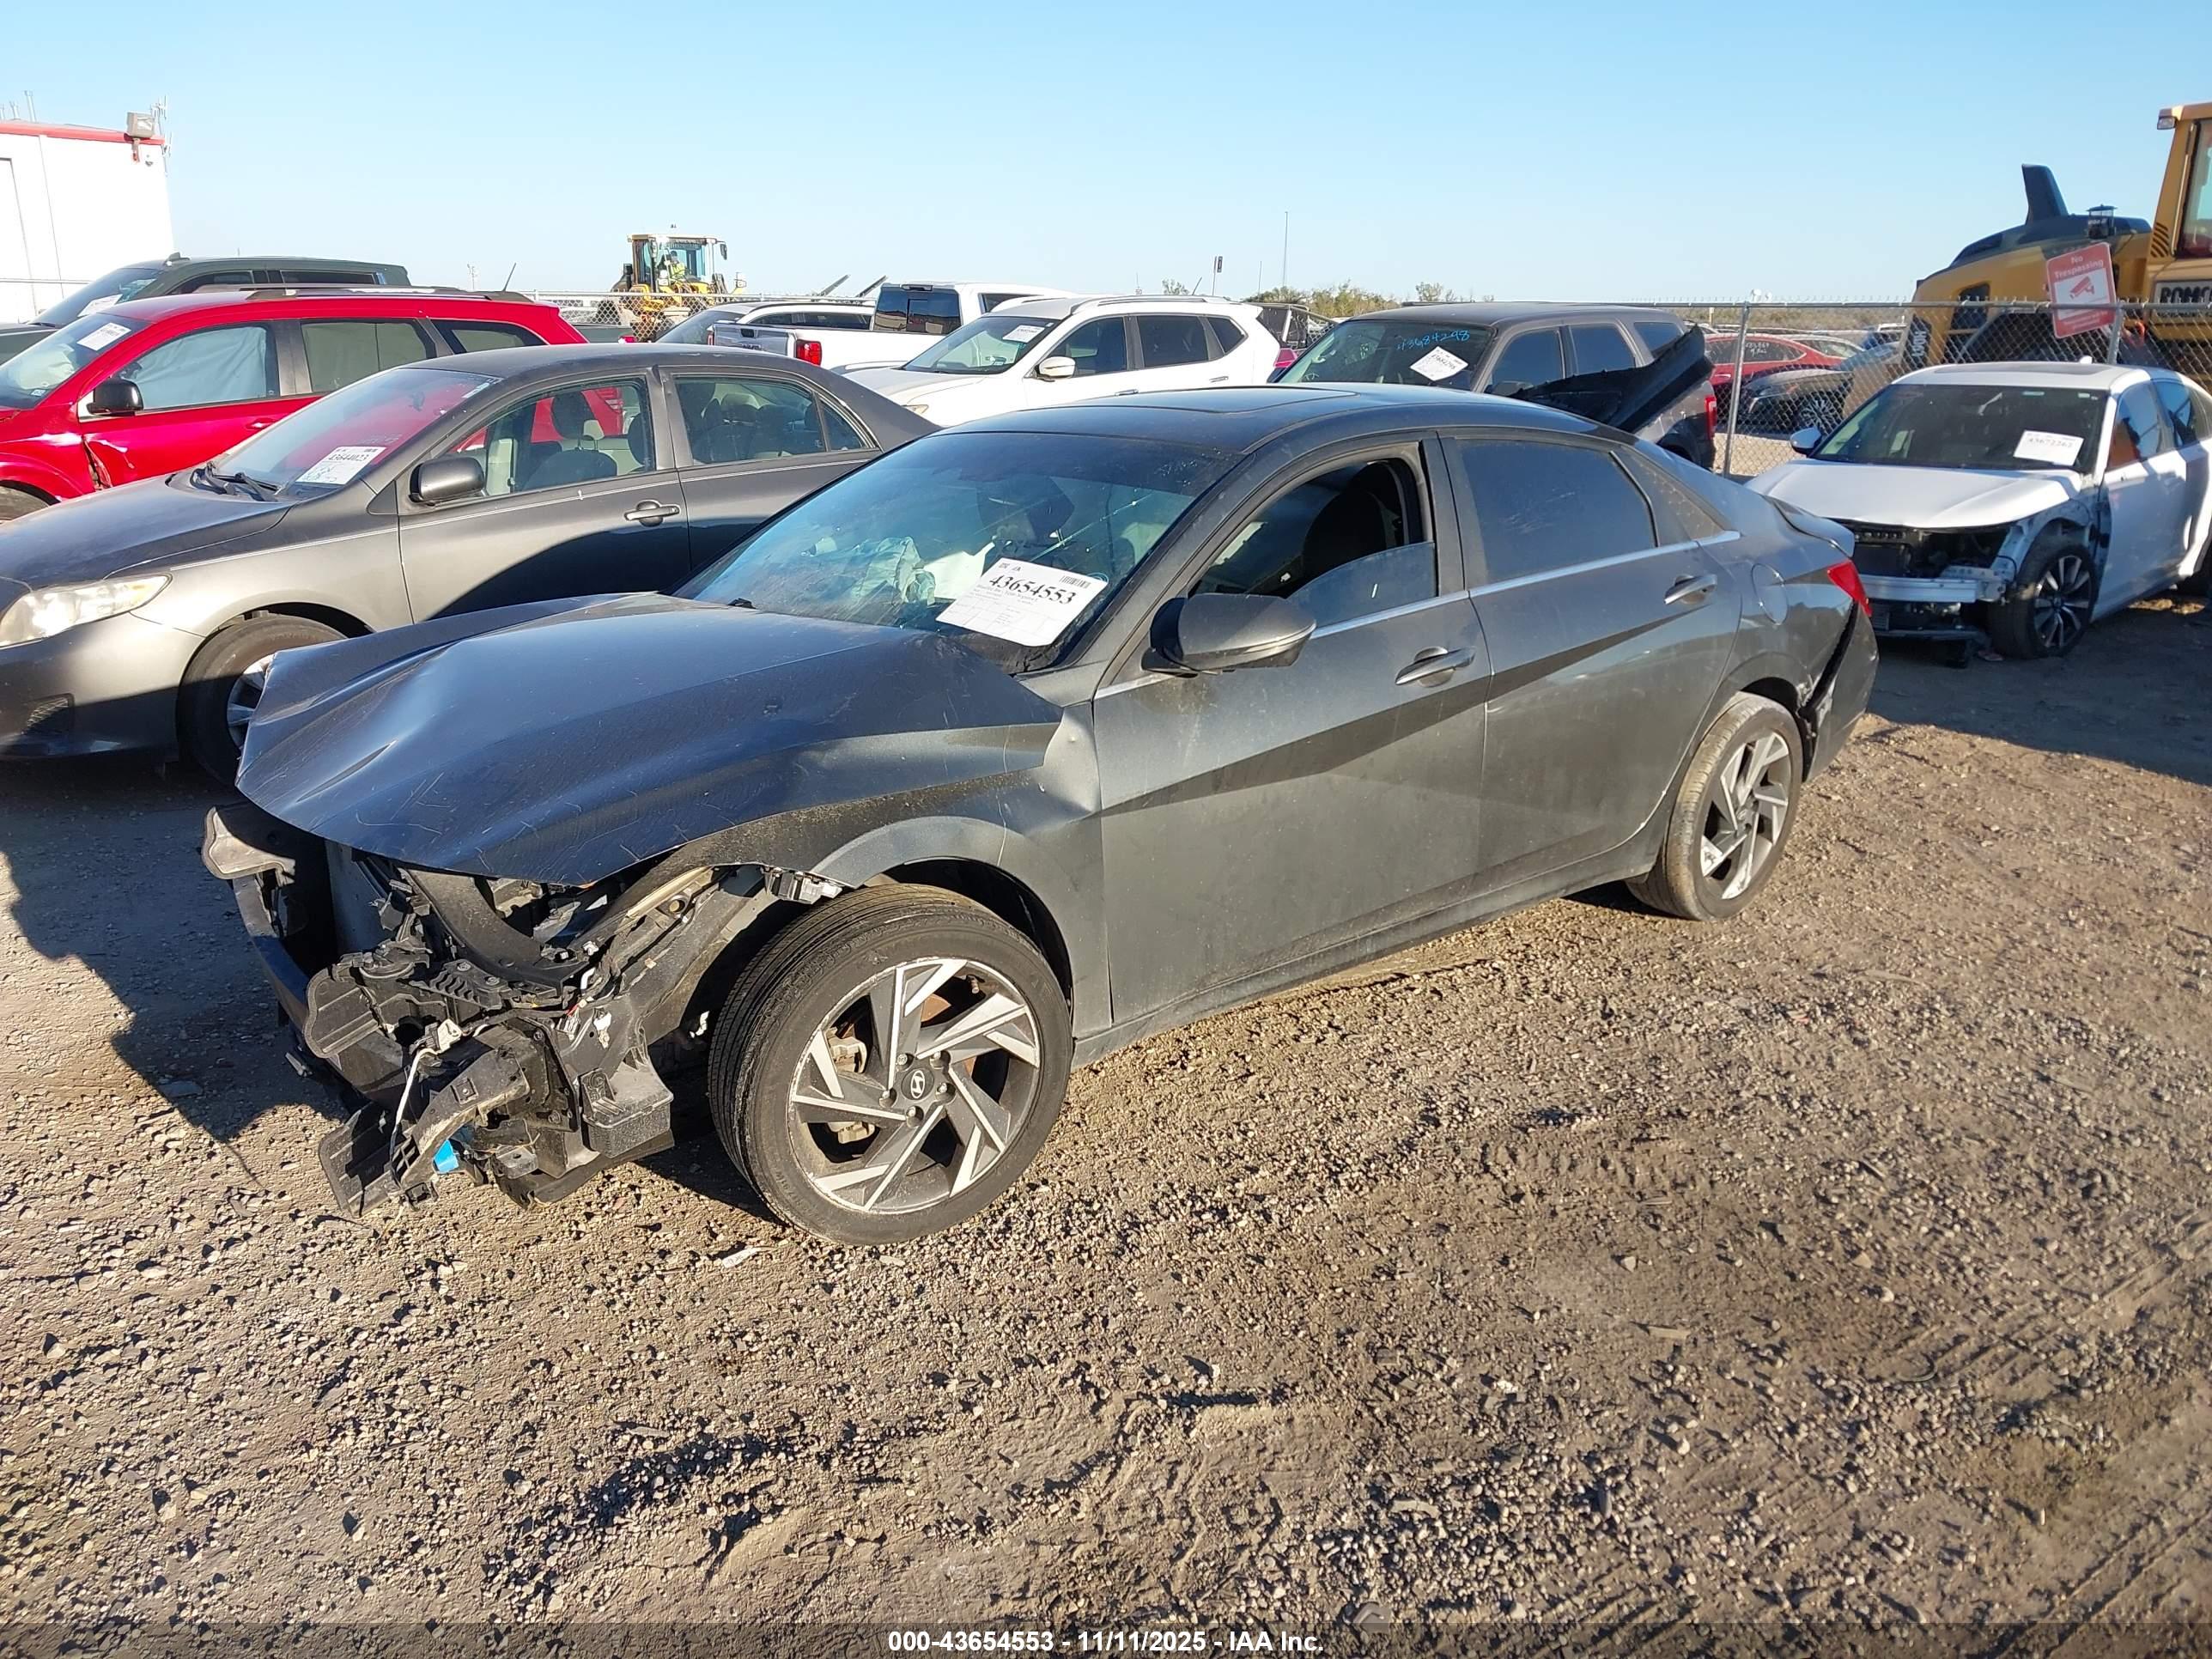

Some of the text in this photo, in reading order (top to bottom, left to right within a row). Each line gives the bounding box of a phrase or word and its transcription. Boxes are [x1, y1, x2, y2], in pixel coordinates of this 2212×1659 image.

[2054, 258, 2105, 279] Trespassing
[2070, 254, 2083, 264] No
[989, 575, 1077, 605] 43654553
